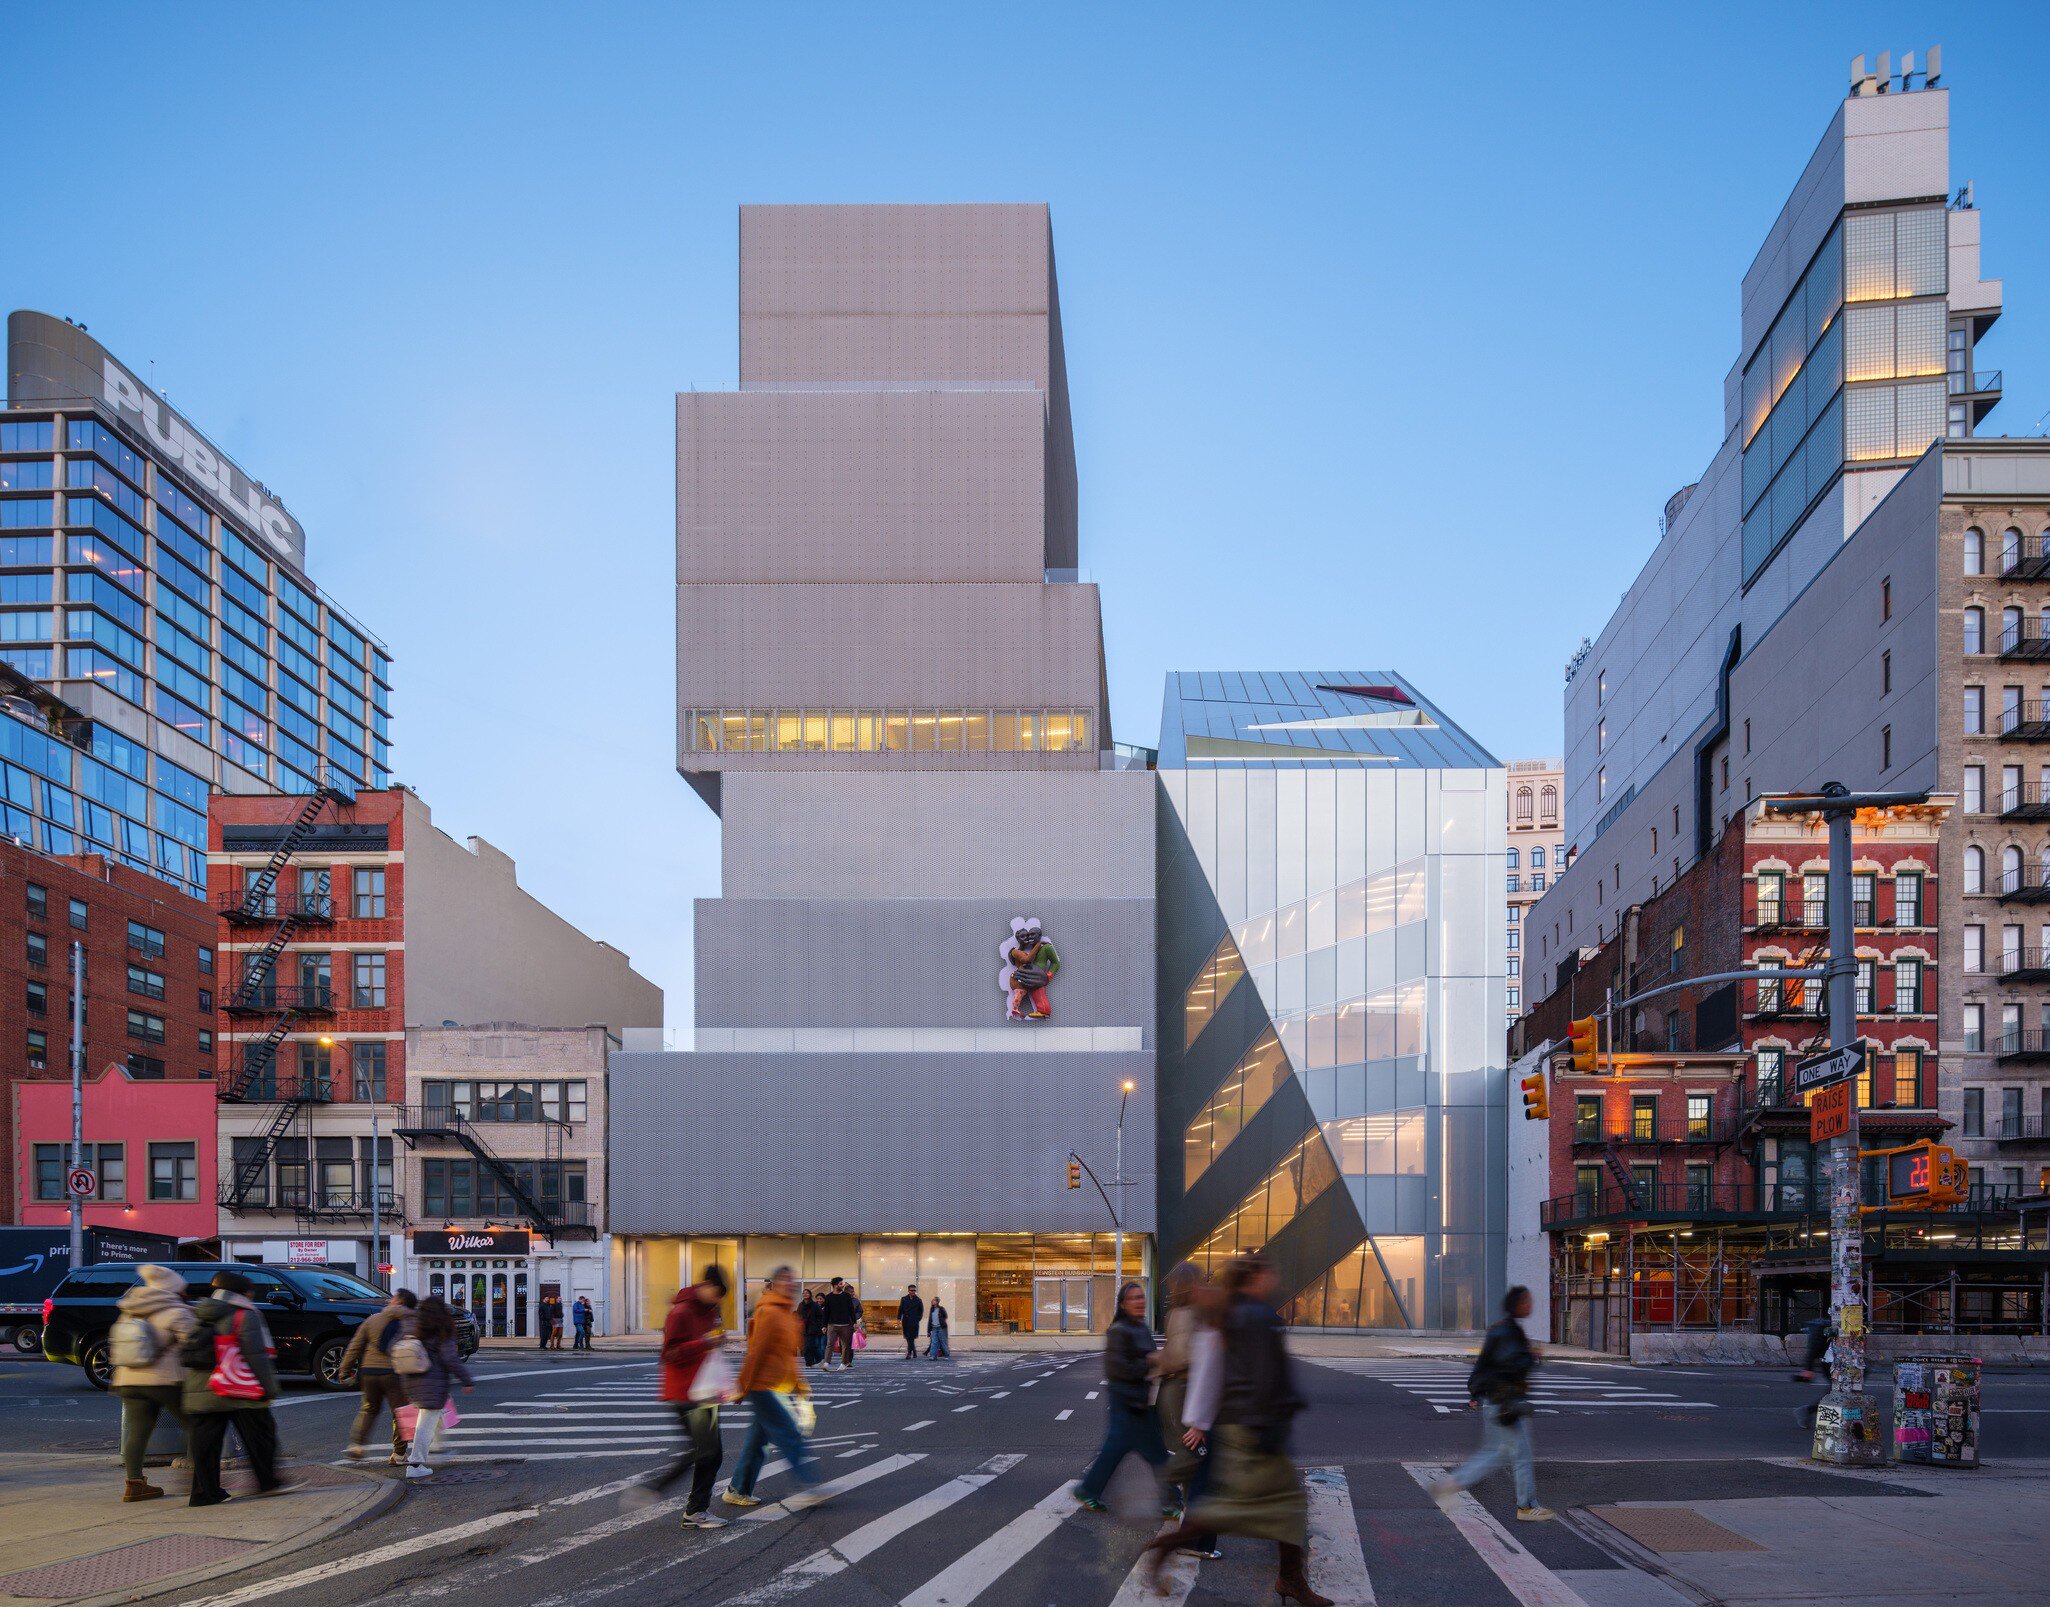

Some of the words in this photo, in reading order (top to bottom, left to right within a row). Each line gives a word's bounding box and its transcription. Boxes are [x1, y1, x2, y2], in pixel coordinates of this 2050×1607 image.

[103, 358, 293, 554] PUBLIC
[1803, 1066, 1820, 1082] ONE
[1830, 1054, 1851, 1073] WAY
[1816, 1089, 1844, 1114] RAISE
[1816, 1114, 1843, 1136] PLOW
[49, 1244, 83, 1257] pri
[100, 1241, 128, 1251] There's
[129, 1246, 148, 1254] more
[448, 1234, 494, 1251] Wilka's
[110, 1250, 134, 1260] Prime.
